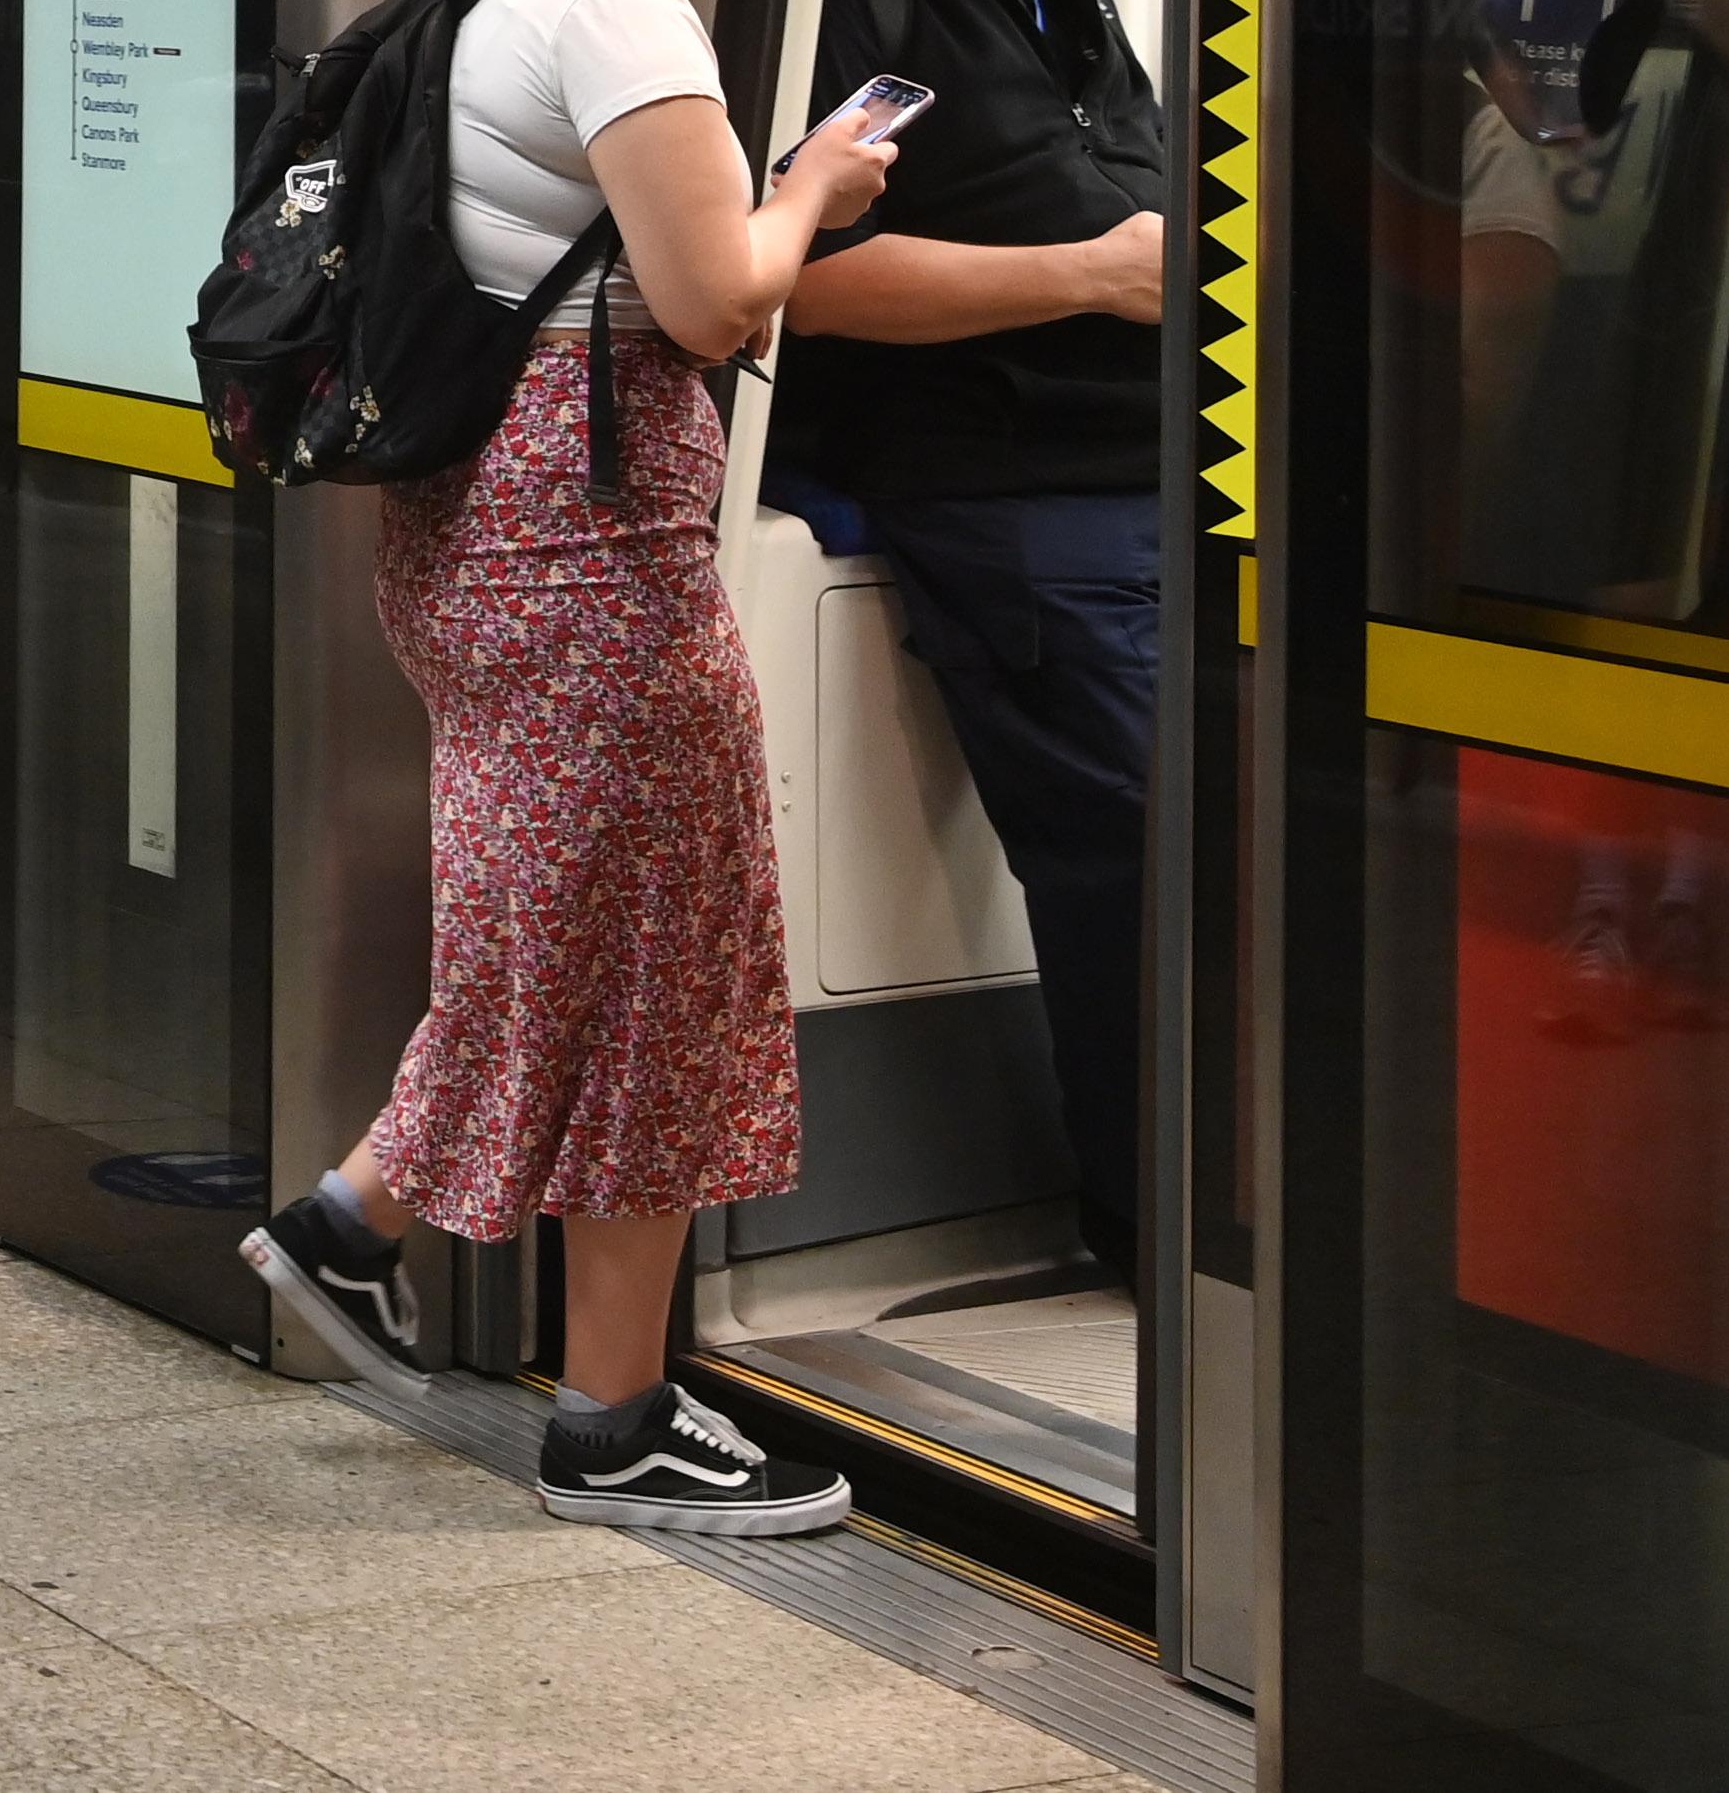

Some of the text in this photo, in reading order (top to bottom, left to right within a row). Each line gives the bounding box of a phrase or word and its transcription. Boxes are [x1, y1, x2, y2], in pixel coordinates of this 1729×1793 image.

[82, 12, 123, 28] Neasden
[82, 39, 125, 59] Wembley
[128, 42, 148, 57] Park
[82, 68, 127, 88] Kingsbury
[82, 96, 139, 118] Queensbury
[82, 124, 140, 143] Canons Park
[82, 153, 126, 171] Stanmore
